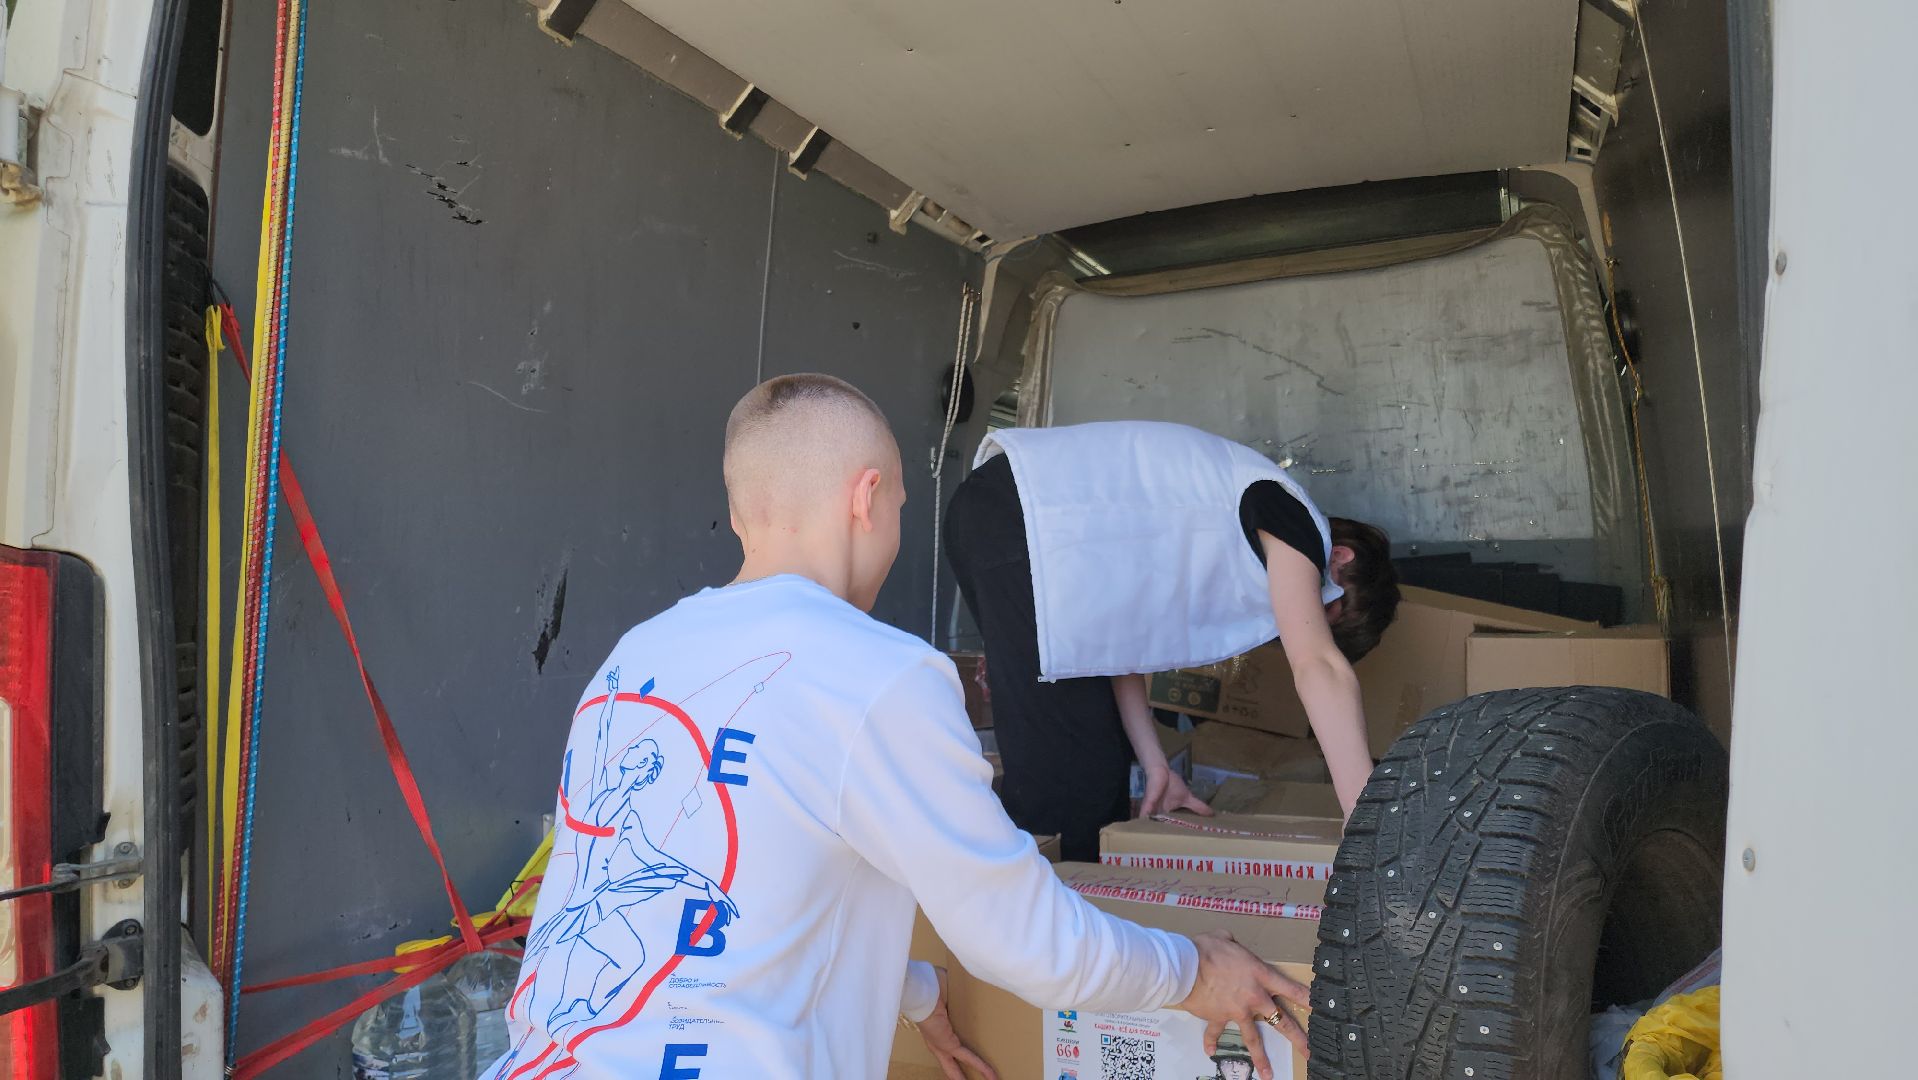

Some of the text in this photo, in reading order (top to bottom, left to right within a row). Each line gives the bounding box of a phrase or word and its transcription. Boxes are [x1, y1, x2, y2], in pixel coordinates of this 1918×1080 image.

[707, 727, 756, 786] Е
[1225, 861, 1314, 879] ХРУПКОЕ!!!
[675, 898, 728, 957] В
